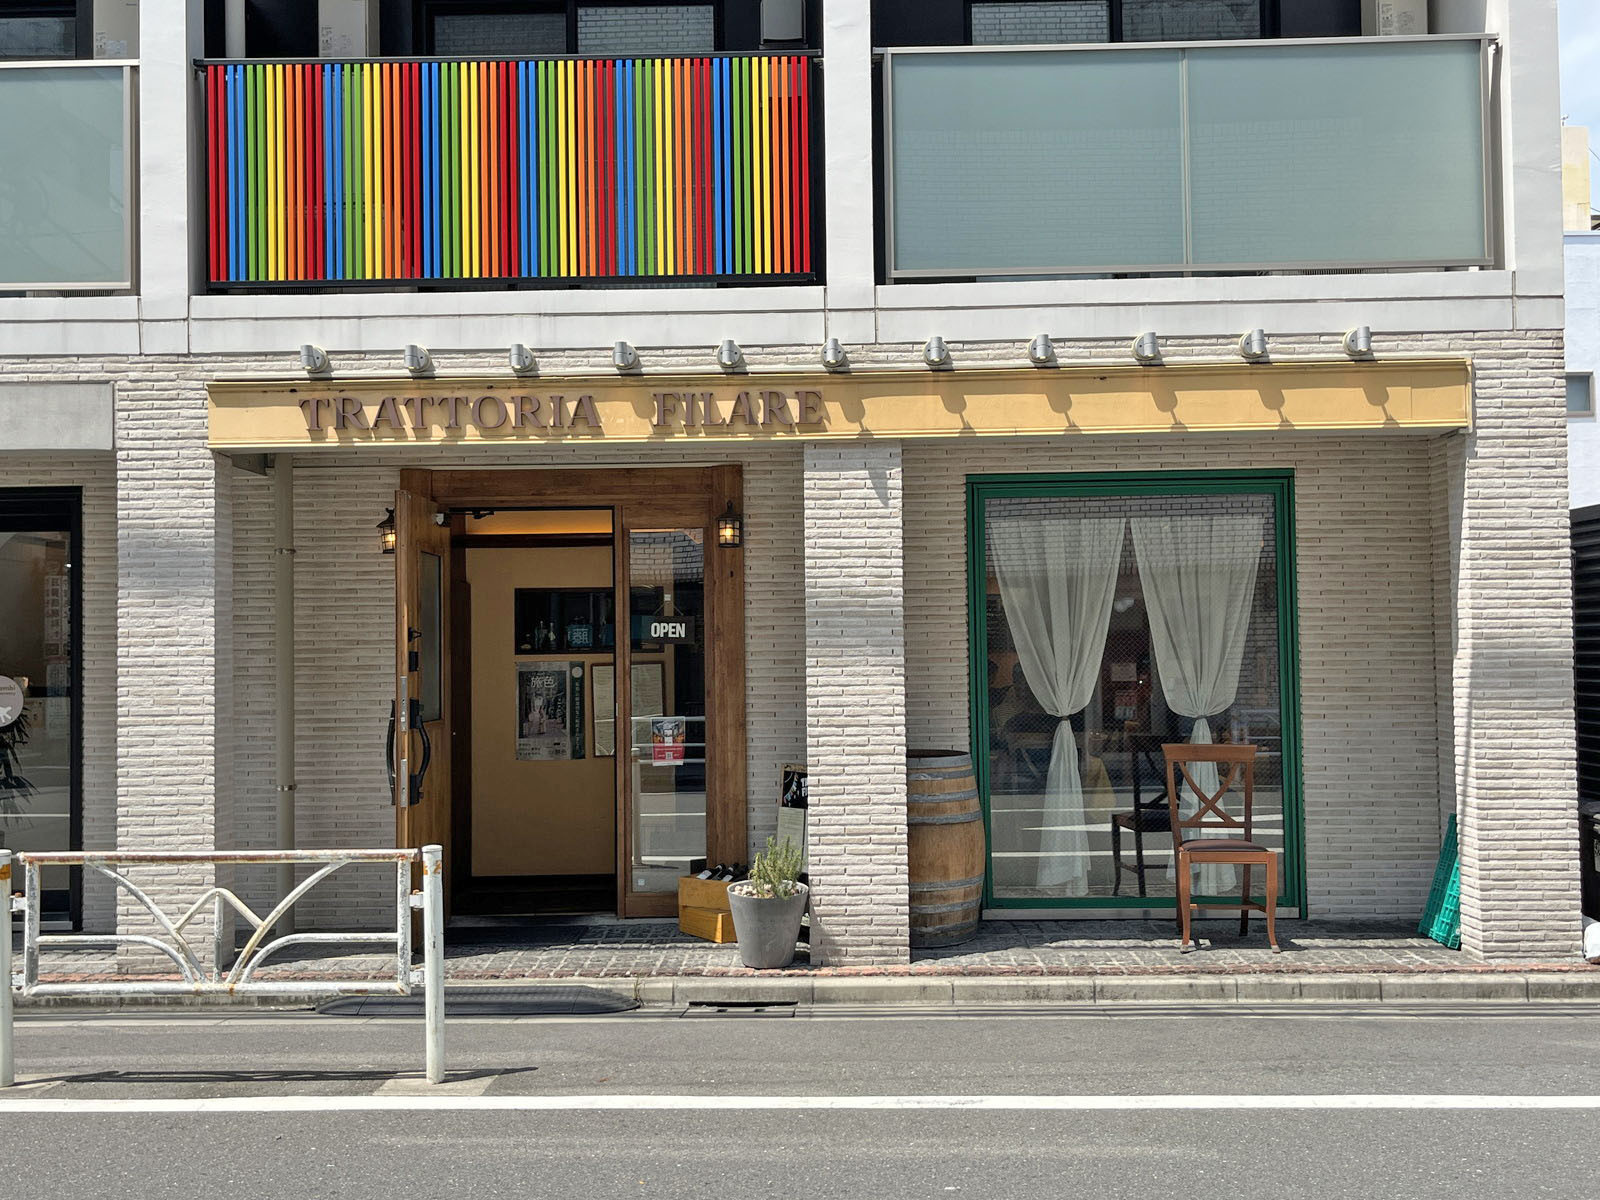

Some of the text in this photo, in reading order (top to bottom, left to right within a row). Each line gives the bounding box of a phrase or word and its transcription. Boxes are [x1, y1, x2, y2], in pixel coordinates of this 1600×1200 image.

[299, 391, 823, 431] TRATTORIA FILARE
[651, 622, 686, 638] OPEN
